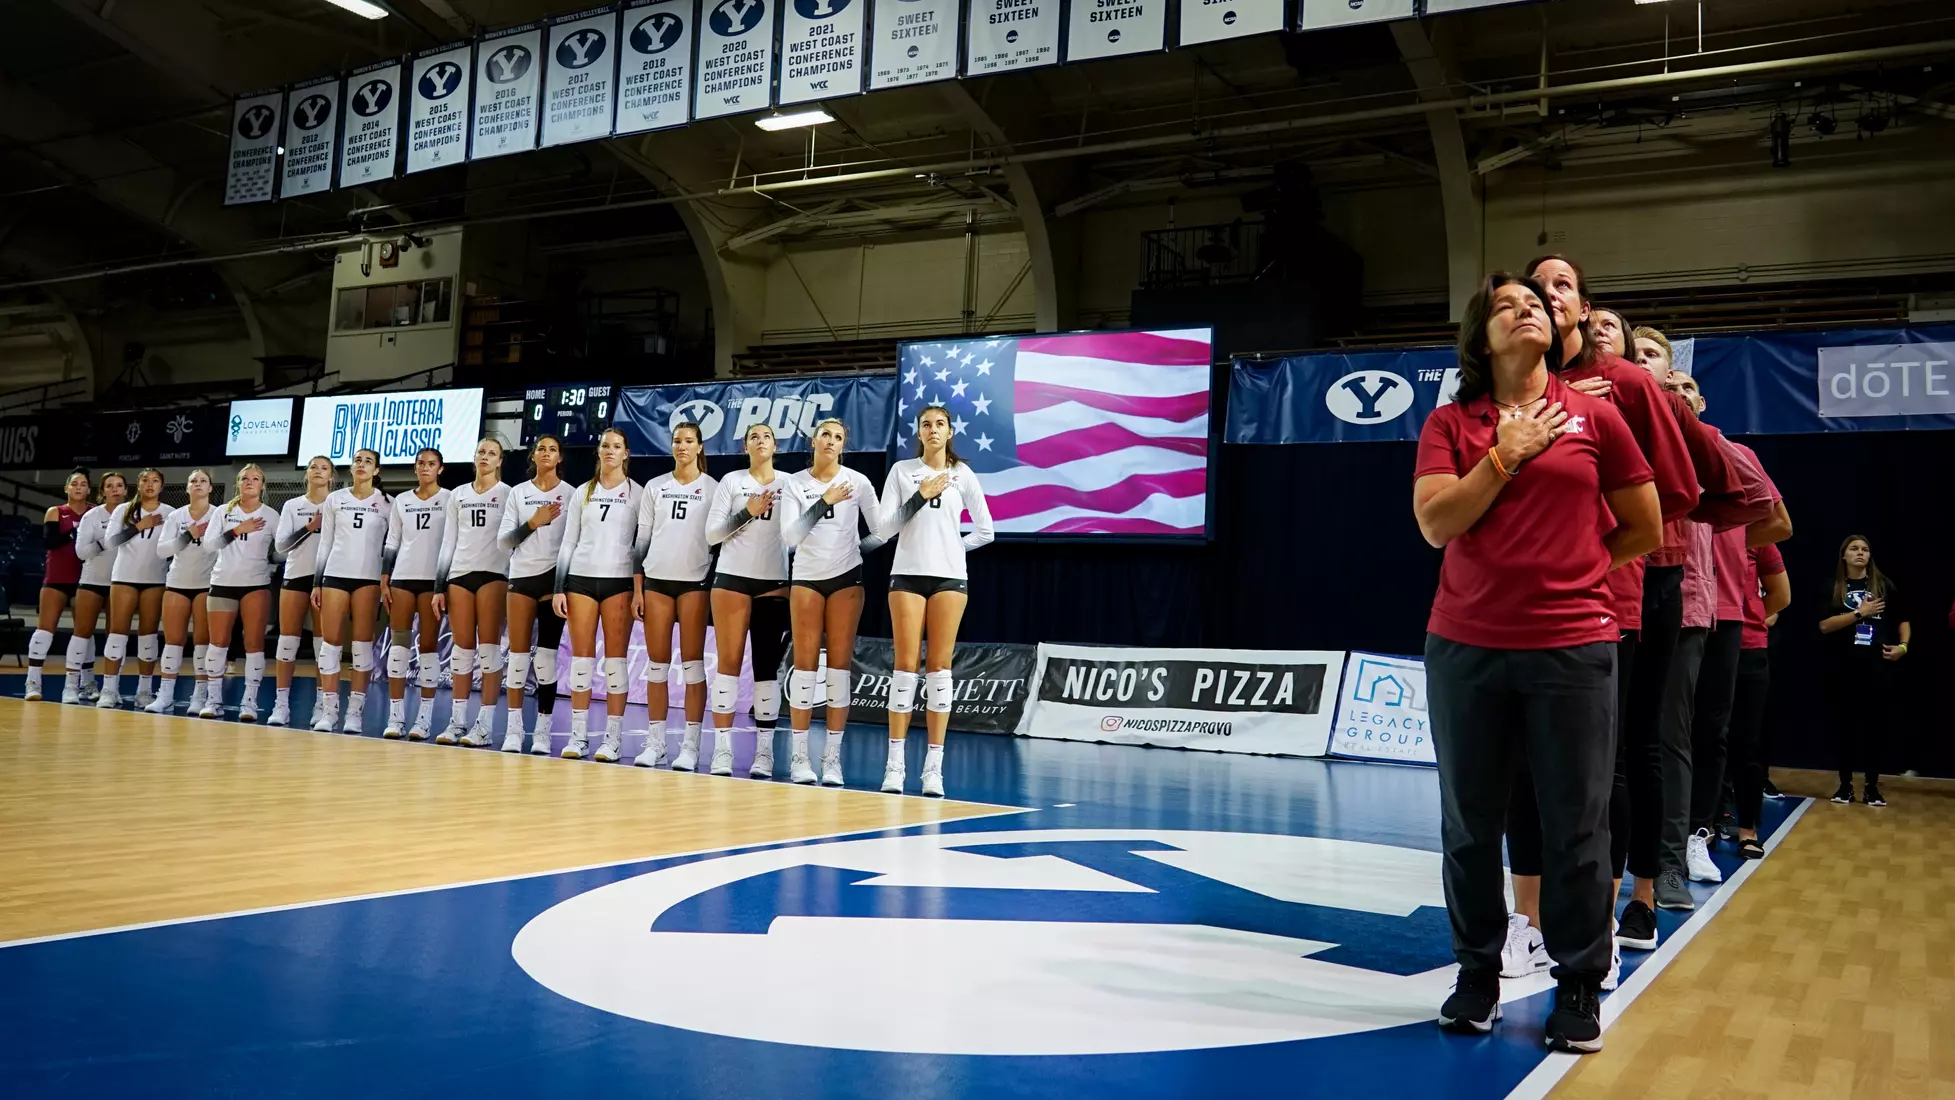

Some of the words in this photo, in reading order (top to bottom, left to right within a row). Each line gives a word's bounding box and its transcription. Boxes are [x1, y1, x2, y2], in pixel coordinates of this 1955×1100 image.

[898, 11, 935, 26] SWEET
[989, 7, 1039, 24] SIXTEEN
[1090, 6, 1143, 22] SIXTEEN
[809, 23, 835, 37] 2021
[891, 23, 939, 40] SIXTEEN
[722, 40, 747, 54] 2020
[790, 39, 817, 53] WEST
[821, 33, 855, 48] COAST
[642, 58, 666, 71] 2018
[705, 56, 730, 70] WEST
[733, 49, 765, 64] COAST
[788, 46, 855, 66] CONFERENCE
[626, 73, 649, 86] WEST
[653, 66, 683, 81] COAST
[704, 62, 765, 82] CONFERENCE
[789, 60, 853, 79] CHAMPIONS
[568, 73, 589, 85] 2017
[704, 75, 763, 94] CHAMPIONS
[810, 80, 828, 90] WCC
[495, 88, 516, 100] 2016
[552, 87, 575, 100] WEST
[578, 81, 607, 94] COAST
[624, 79, 683, 98] CONFERENCE
[480, 101, 502, 114] WEST
[504, 96, 531, 109] COAST
[551, 93, 606, 112] CONFERENCE
[625, 92, 681, 110] CHAMPIONS
[723, 95, 740, 105] WCC
[429, 103, 448, 115] 2015
[478, 108, 531, 125] CONFERENCE
[551, 105, 604, 123] CHAMPIONS
[362, 120, 380, 132] 2014
[414, 118, 435, 129] WEST
[437, 111, 462, 124] COAST
[479, 120, 529, 137] CHAMPIONS
[302, 134, 319, 144] 2012
[348, 133, 367, 145] WEST
[369, 128, 391, 141] COAST
[414, 122, 462, 140] CONFERENCE
[289, 144, 306, 157] WEST
[308, 142, 330, 153] COAST
[347, 139, 391, 156] CONFERENCE
[414, 134, 460, 151] CHAMPIONS
[233, 146, 273, 160] CONFERENCE
[287, 152, 329, 167] CONFERENCE
[347, 150, 389, 166] CHAMPIONS
[233, 156, 272, 169] CHAMPIONS
[287, 163, 327, 178] CHAMPIONS
[1418, 369, 1443, 382] THE
[526, 389, 546, 400] HOME
[561, 389, 585, 406] 1:30
[588, 386, 611, 397] GUEST
[534, 404, 543, 420] 0
[597, 401, 607, 418] 0
[727, 400, 743, 409] THE
[243, 420, 289, 429] LOVELAND
[733, 393, 834, 440] ROC
[331, 402, 380, 458] BYU
[387, 398, 443, 426] DOTERRA
[564, 423, 570, 437] 1
[384, 428, 442, 458] CLASSIC
[471, 509, 486, 527] 16
[600, 504, 610, 522] 7
[671, 500, 688, 520] 15
[353, 512, 364, 529] 5
[416, 513, 431, 530] 12
[1061, 665, 1168, 701] NICO'S
[1192, 668, 1294, 706] PIZZA
[956, 705, 1008, 715] BEAUTY
[1123, 718, 1232, 736] NICOSPIZZAPROVO
[1350, 710, 1425, 731] LEGACY
[1347, 727, 1423, 746] GROUP
